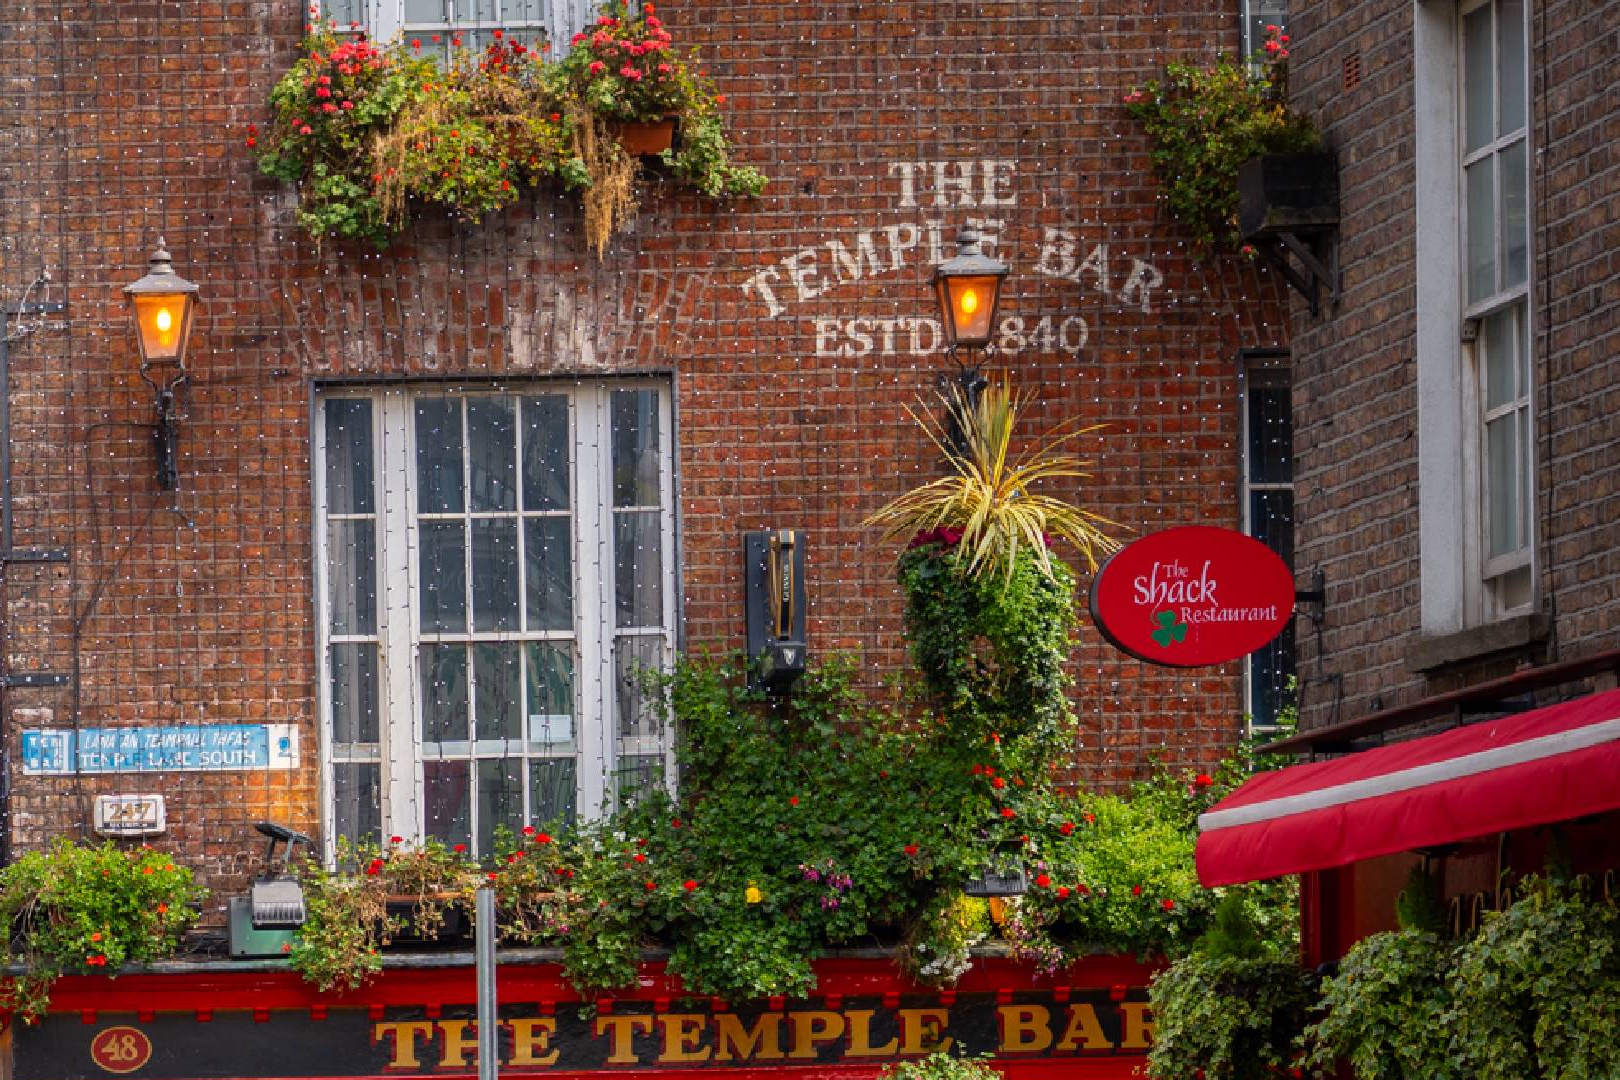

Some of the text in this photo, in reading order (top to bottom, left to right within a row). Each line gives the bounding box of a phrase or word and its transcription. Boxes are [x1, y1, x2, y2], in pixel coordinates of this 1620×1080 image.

[889, 161, 1017, 207] THE
[1034, 226, 1164, 313] BAR
[990, 315, 1088, 355] 840
[1133, 559, 1219, 610] Shack
[1162, 559, 1188, 578] The
[1180, 604, 1277, 624] Restaurant
[198, 749, 257, 766] SOUTH
[101, 1033, 138, 1061] 48
[376, 1017, 560, 1068] THE
[596, 1007, 955, 1065] TEMPLE
